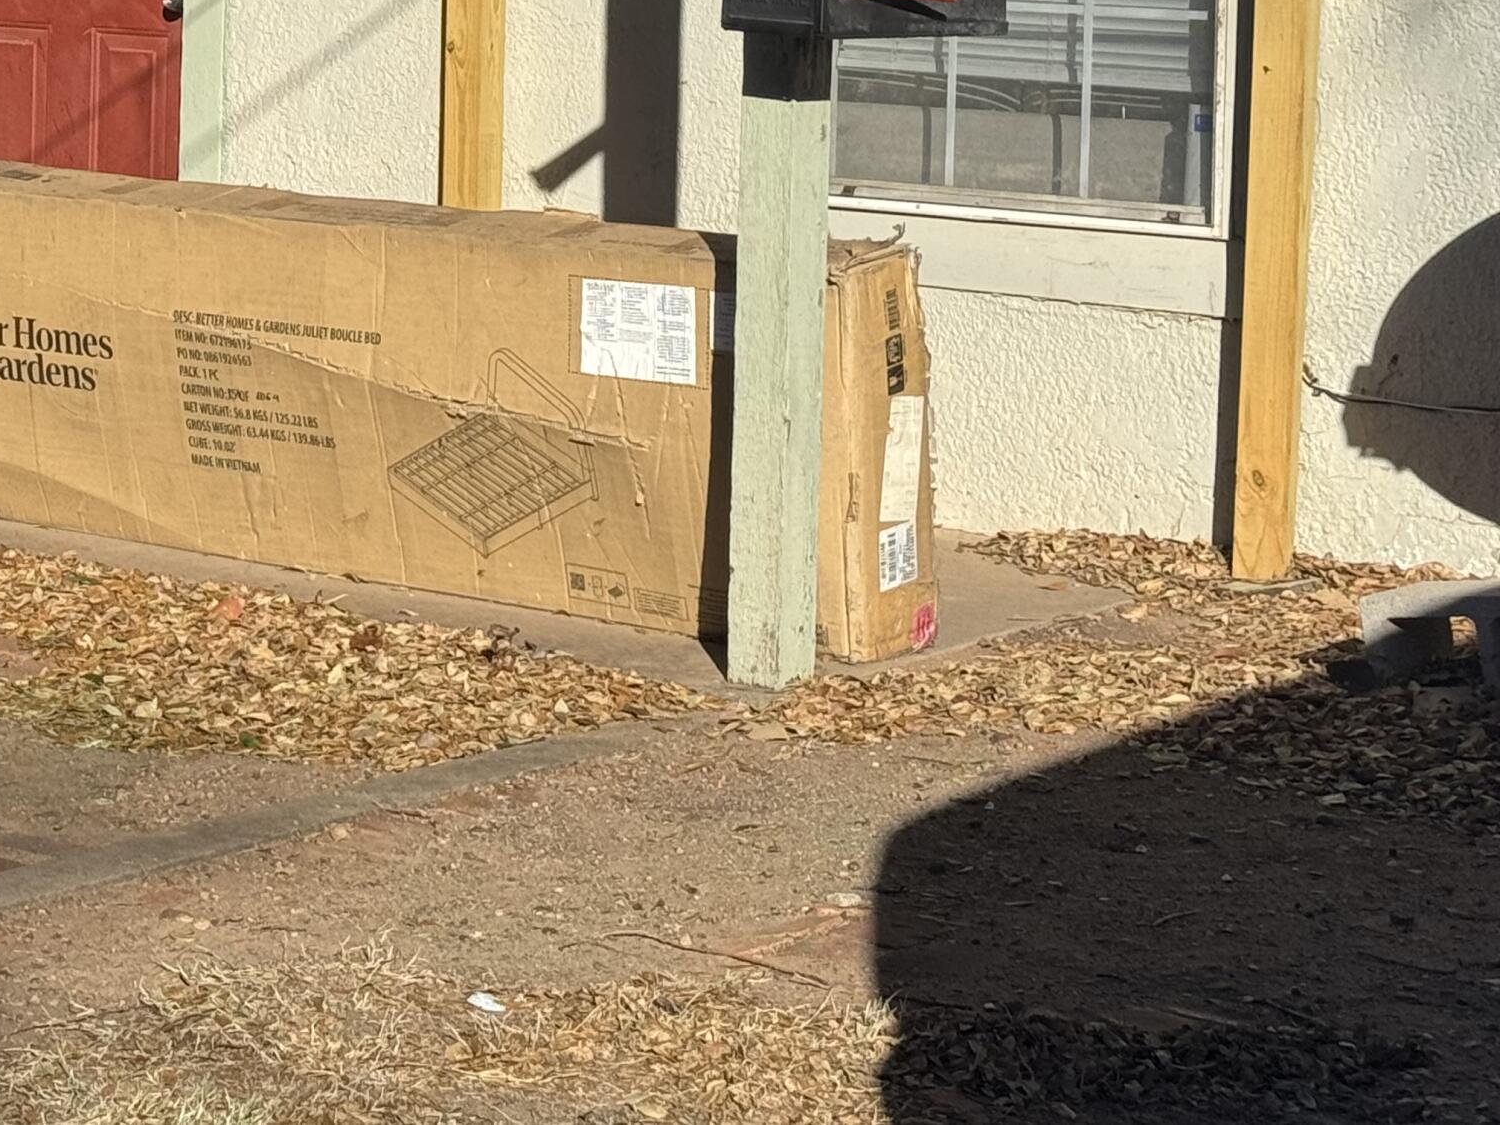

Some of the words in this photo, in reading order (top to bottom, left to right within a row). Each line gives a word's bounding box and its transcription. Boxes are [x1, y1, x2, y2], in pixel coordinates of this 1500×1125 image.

[12, 316, 114, 359] Homes
[174, 328, 193, 343] ITEM
[194, 331, 208, 345] NO:
[196, 311, 225, 327] BETTER
[226, 315, 254, 331] HOMES
[255, 318, 262, 332] &
[263, 320, 301, 336] GARDENS
[301, 323, 329, 340] JULIET
[330, 327, 362, 344] BOUCLE
[364, 330, 382, 345] BED
[176, 346, 188, 359] PO
[189, 348, 203, 361] NO:
[202, 368, 207, 381] 1
[208, 368, 219, 382] PC
[181, 382, 212, 398] CARTON
[183, 400, 198, 413] NET
[199, 402, 232, 418] WEIGHT:
[233, 406, 251, 420] 56.8
[252, 408, 268, 422] KGS
[275, 411, 302, 427] 125.22
[303, 415, 319, 429] LBS
[185, 418, 211, 432] GROSS
[211, 421, 245, 437] WEIGHT:
[246, 426, 269, 440] 63.44
[270, 429, 287, 442] KGS
[321, 435, 336, 449] LBS
[188, 435, 212, 450] CUBE:
[191, 453, 214, 467] MADE
[215, 456, 224, 469] IN
[224, 457, 261, 474] VIETNAM
